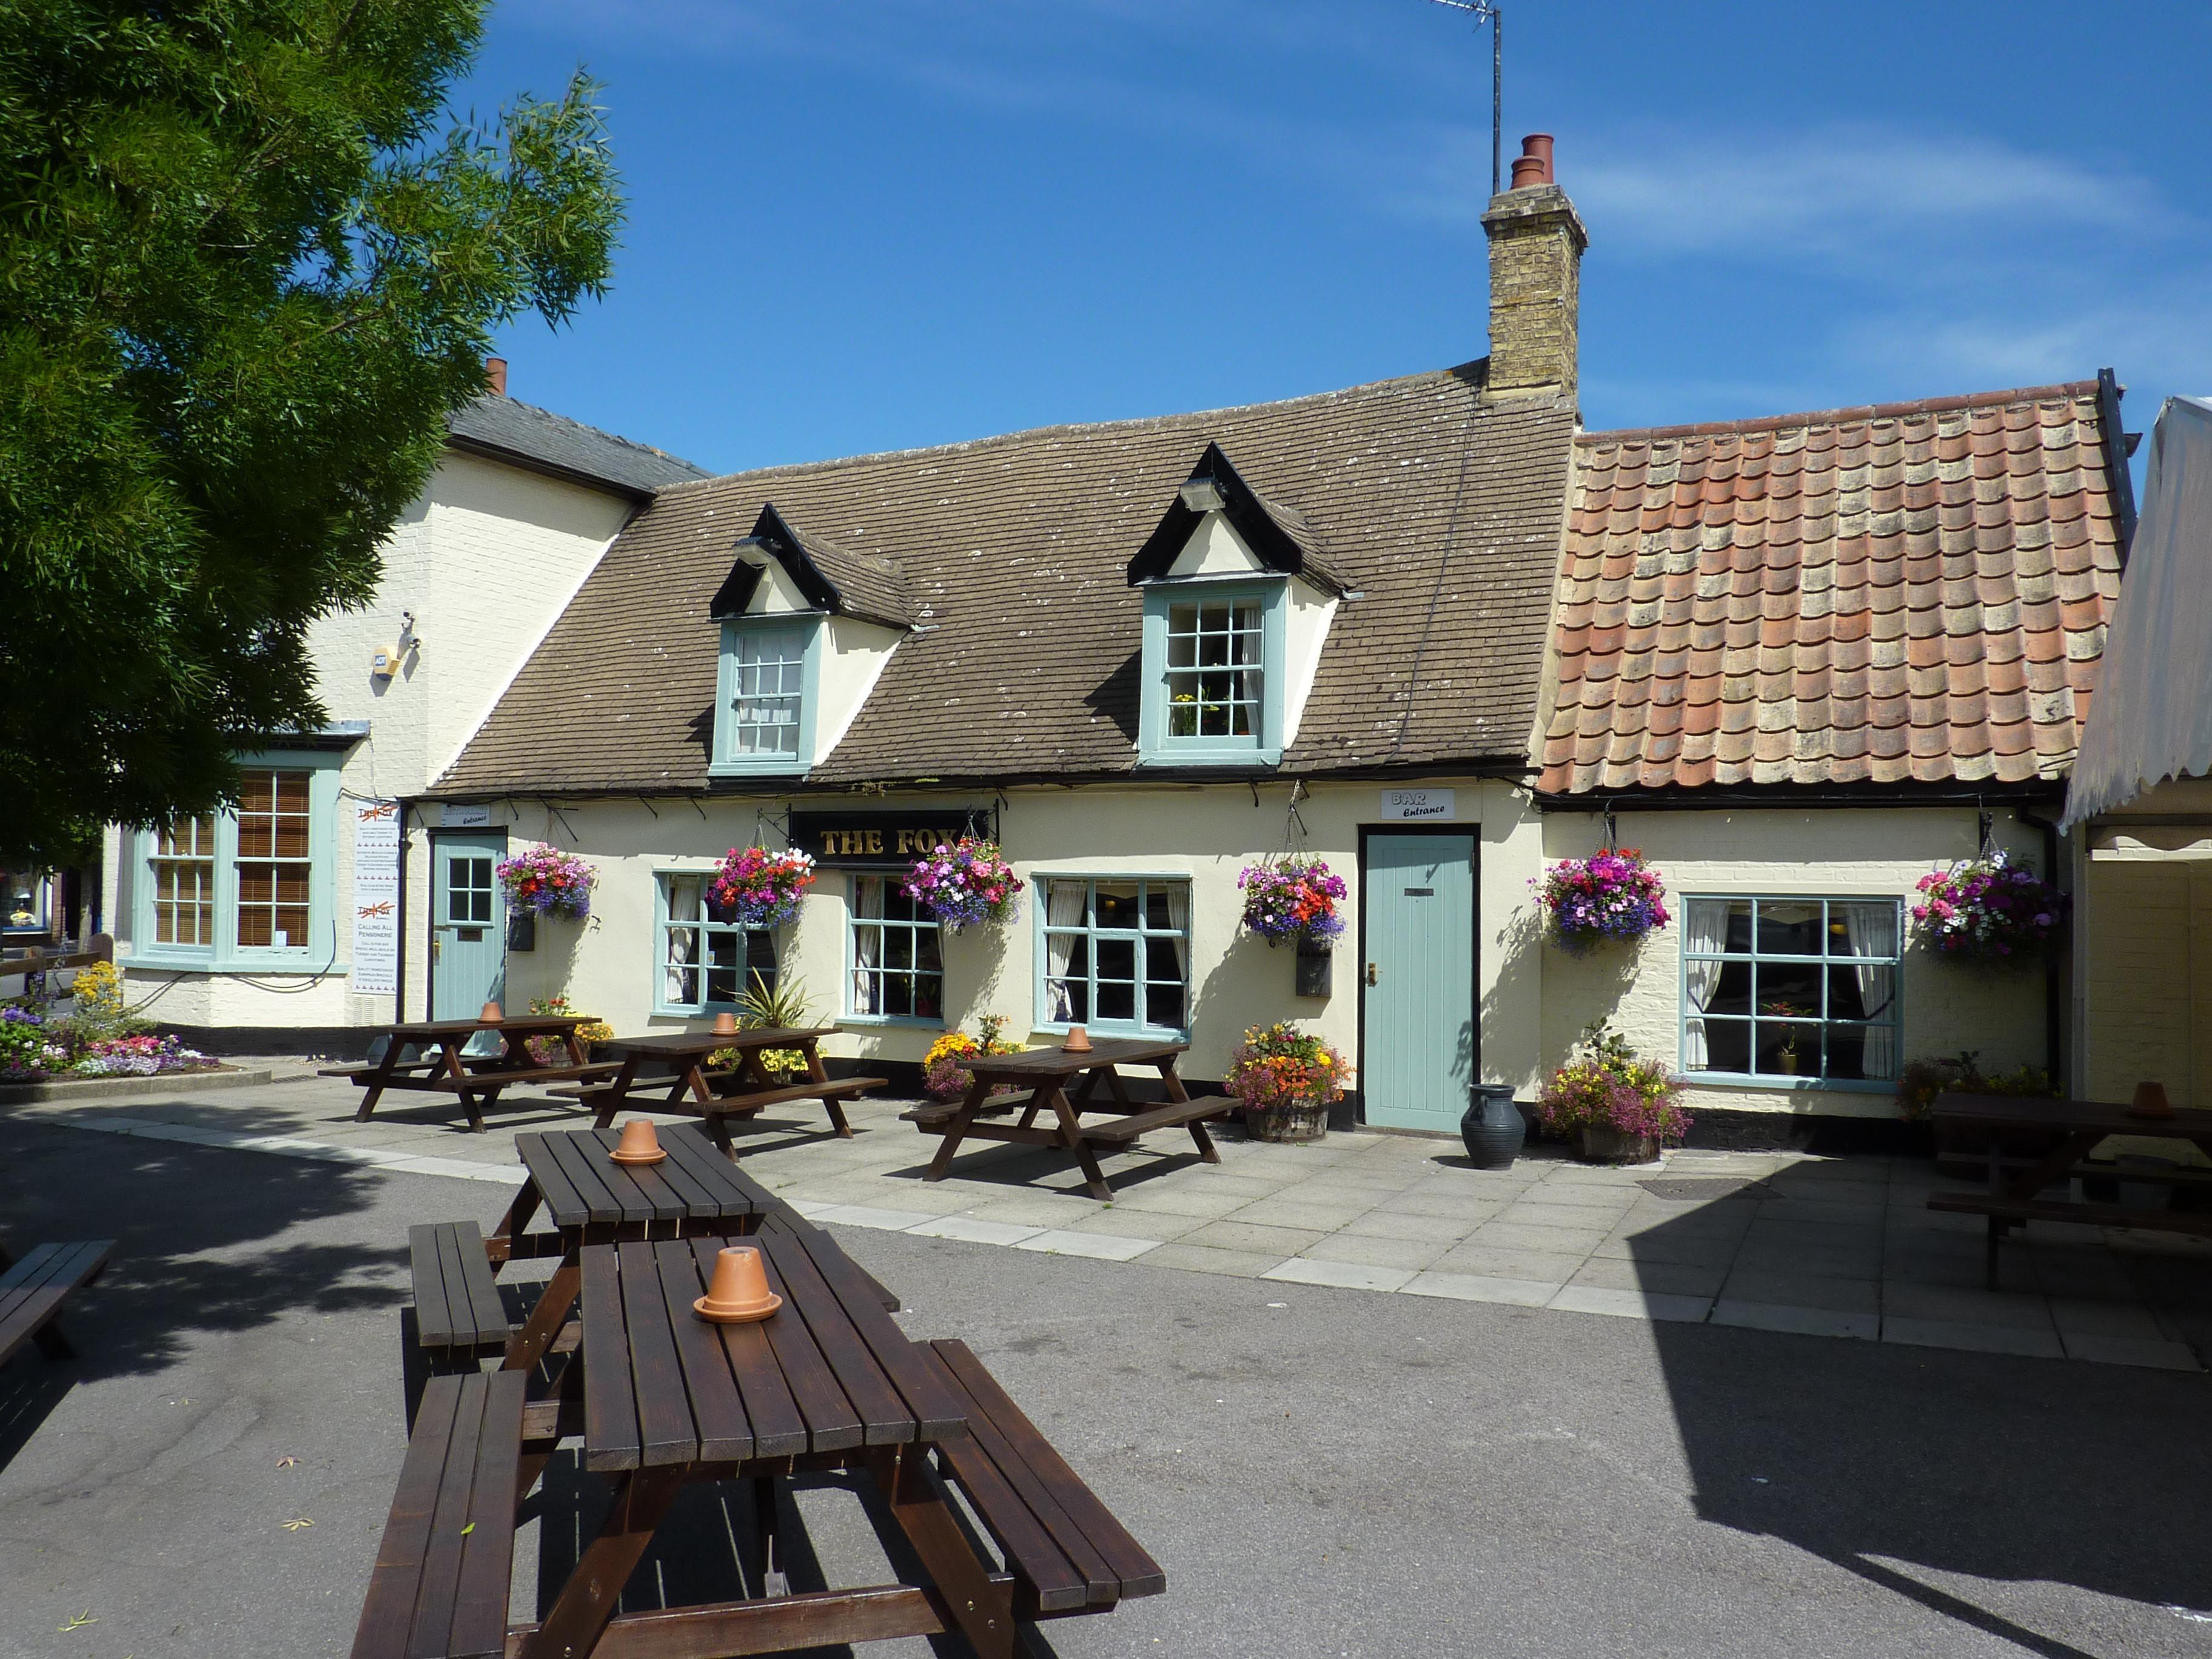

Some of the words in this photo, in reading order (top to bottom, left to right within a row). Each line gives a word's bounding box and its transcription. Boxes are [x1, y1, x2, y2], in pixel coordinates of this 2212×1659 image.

[1392, 792, 1426, 805] BAR
[1403, 806, 1445, 817] Entrance
[463, 816, 487, 825] Entrance
[820, 830, 883, 854] THE
[897, 828, 958, 854] FOX
